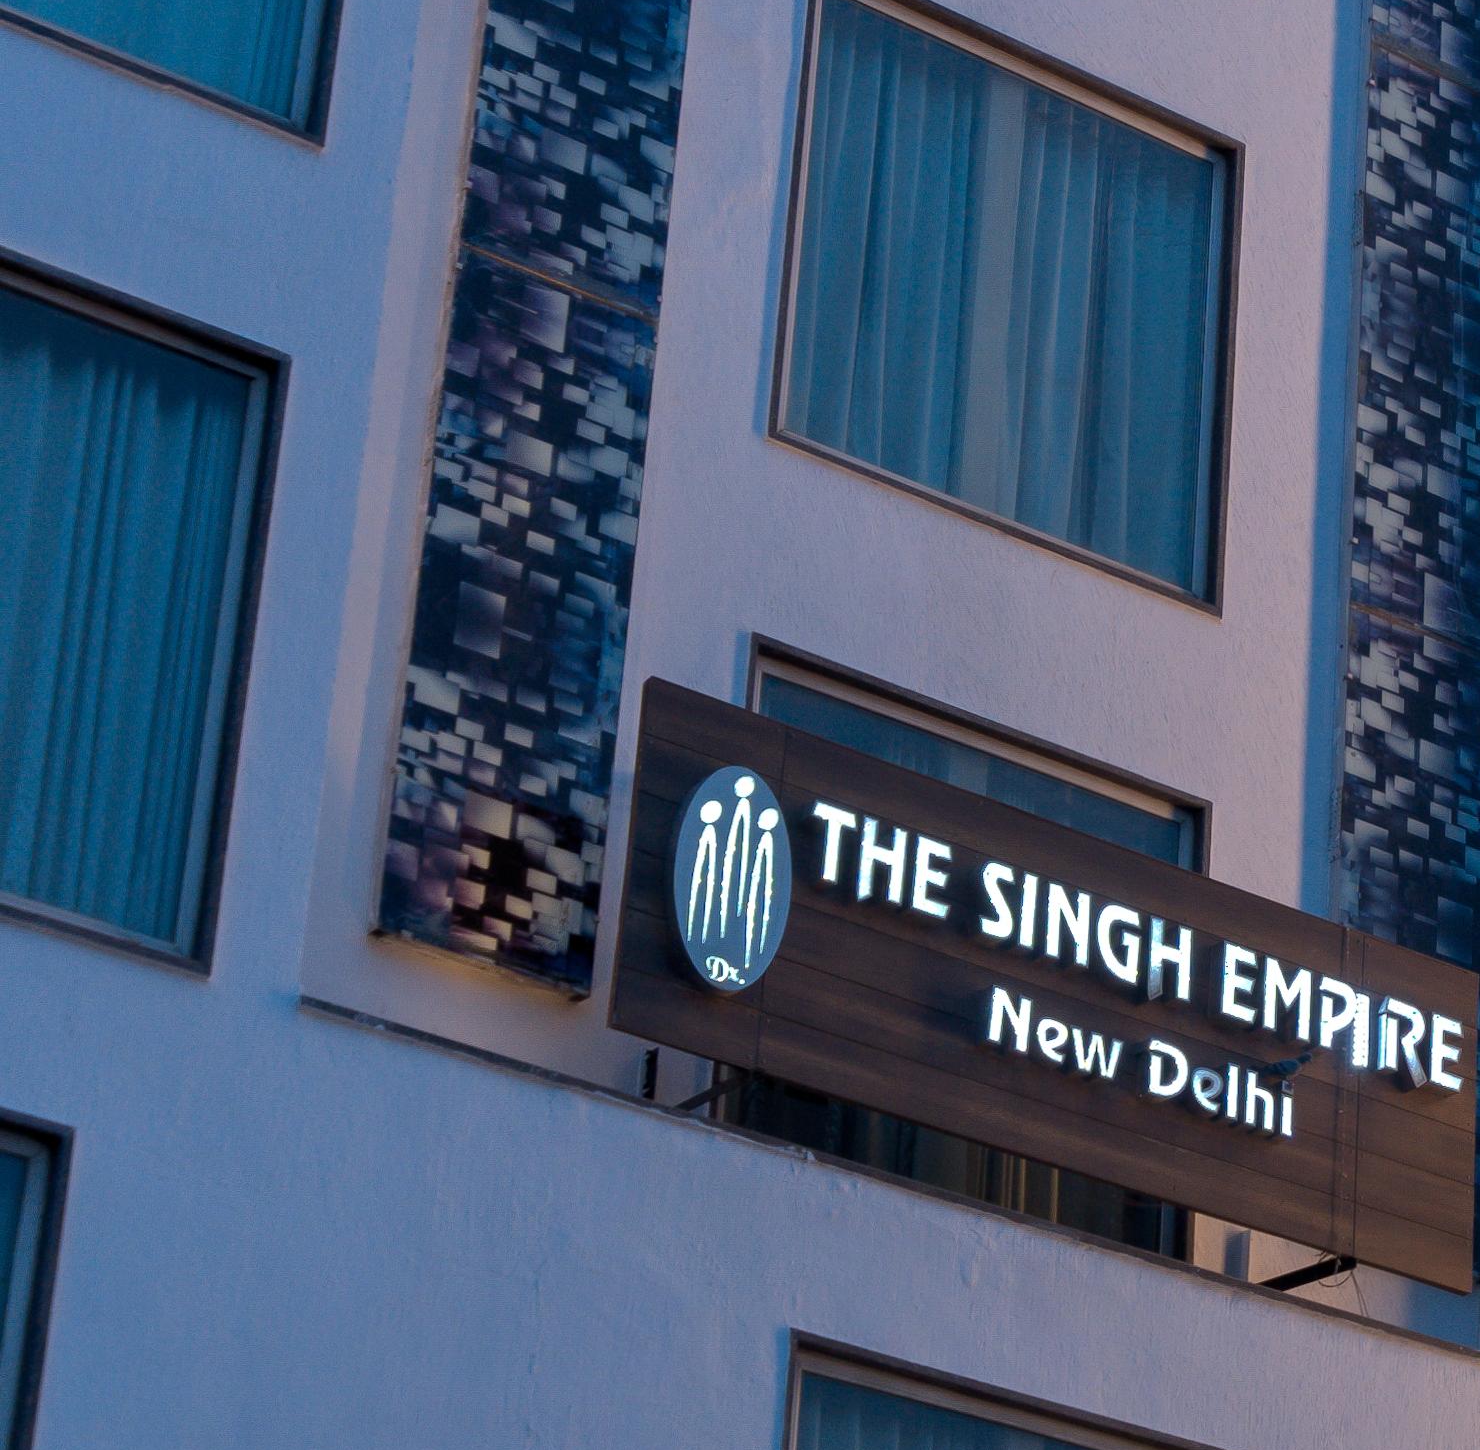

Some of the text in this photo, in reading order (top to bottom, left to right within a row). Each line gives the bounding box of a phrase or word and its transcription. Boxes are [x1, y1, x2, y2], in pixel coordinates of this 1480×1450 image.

[813, 800, 1465, 1094] THE SINGH EMPIRE
[986, 985, 1295, 1139] New Delhi
